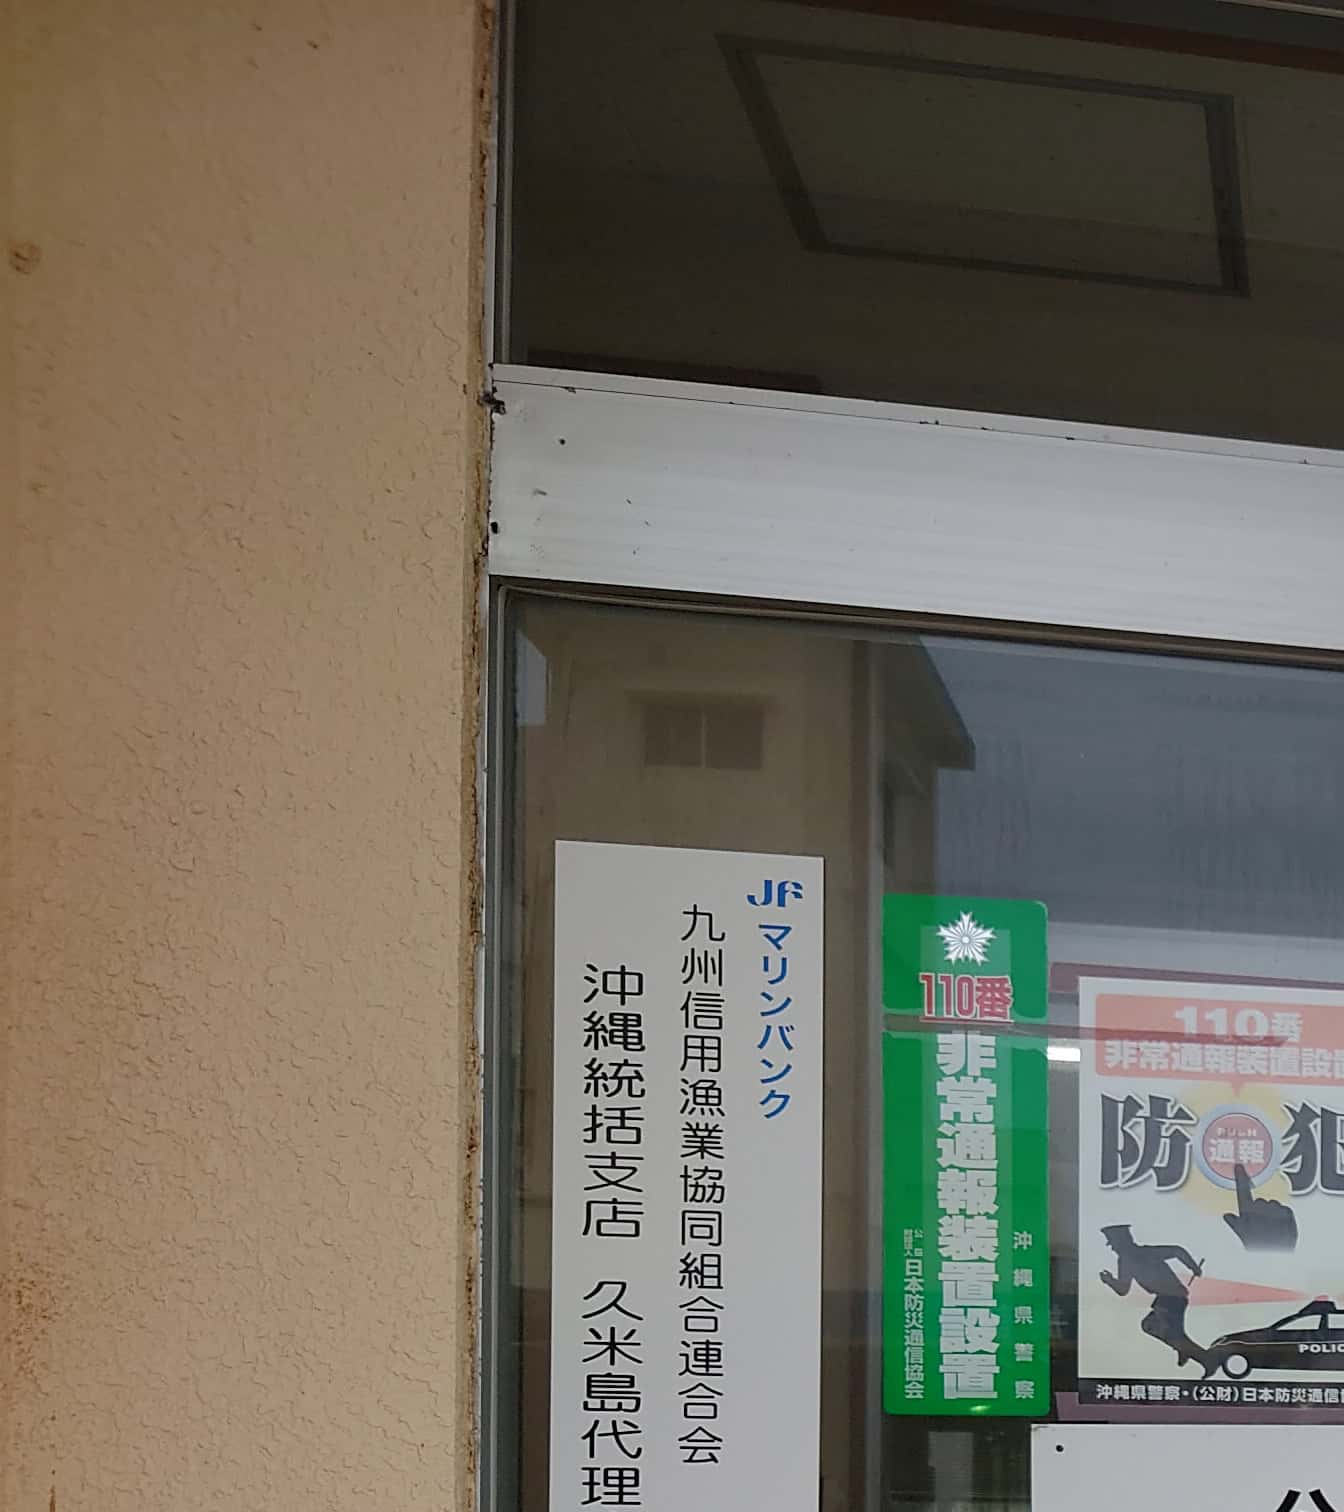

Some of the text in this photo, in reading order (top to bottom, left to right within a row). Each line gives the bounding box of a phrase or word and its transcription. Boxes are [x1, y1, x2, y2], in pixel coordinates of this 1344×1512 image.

[758, 923, 793, 1120] マリンバンク
[919, 973, 1011, 1018] 110番
[1175, 1006, 1303, 1043] 110番
[582, 963, 645, 1238] 沖縄統括支店
[678, 904, 725, 1464] 九州信用漁業協同組合連合会
[1208, 1138, 1264, 1164] 通報
[936, 1031, 1000, 1400] 非常通報装置設置
[904, 1259, 924, 1399] 日本防災通信協会
[1013, 1231, 1034, 1400] 沖縄県警察
